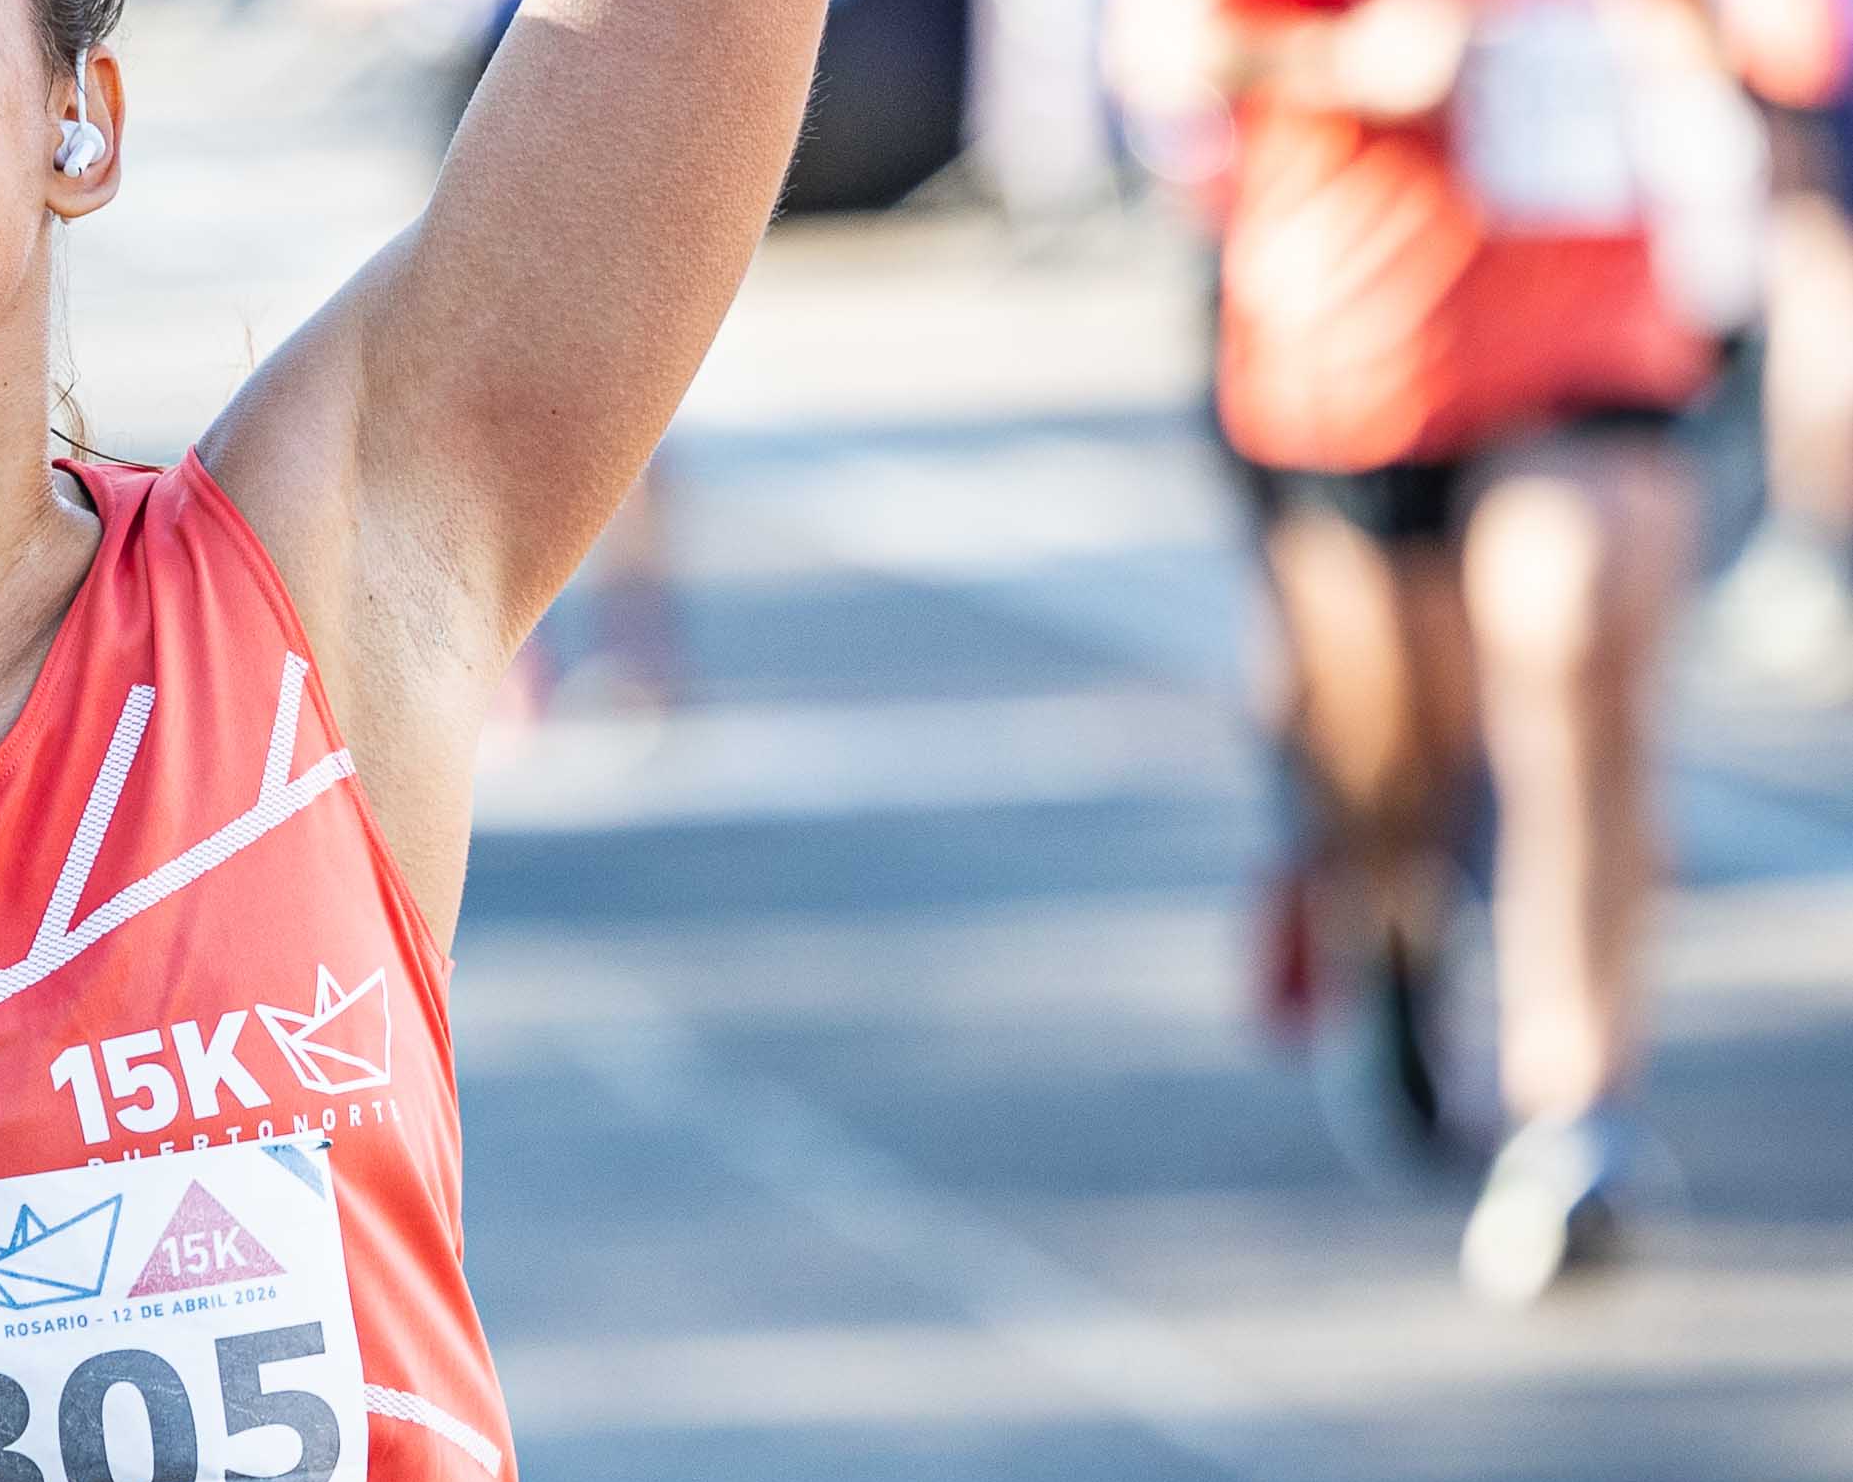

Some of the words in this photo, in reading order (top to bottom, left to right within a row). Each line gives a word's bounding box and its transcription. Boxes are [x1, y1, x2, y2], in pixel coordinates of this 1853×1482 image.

[50, 1010, 271, 1145] 15K
[87, 1119, 274, 1167] ERTO
[160, 1224, 249, 1278] 15K
[4, 1314, 88, 1339] ROSARIO
[112, 1308, 133, 1323] 12
[141, 1302, 165, 1319] DE
[172, 1295, 228, 1315] ABRIL
[234, 1285, 278, 1304] 2026
